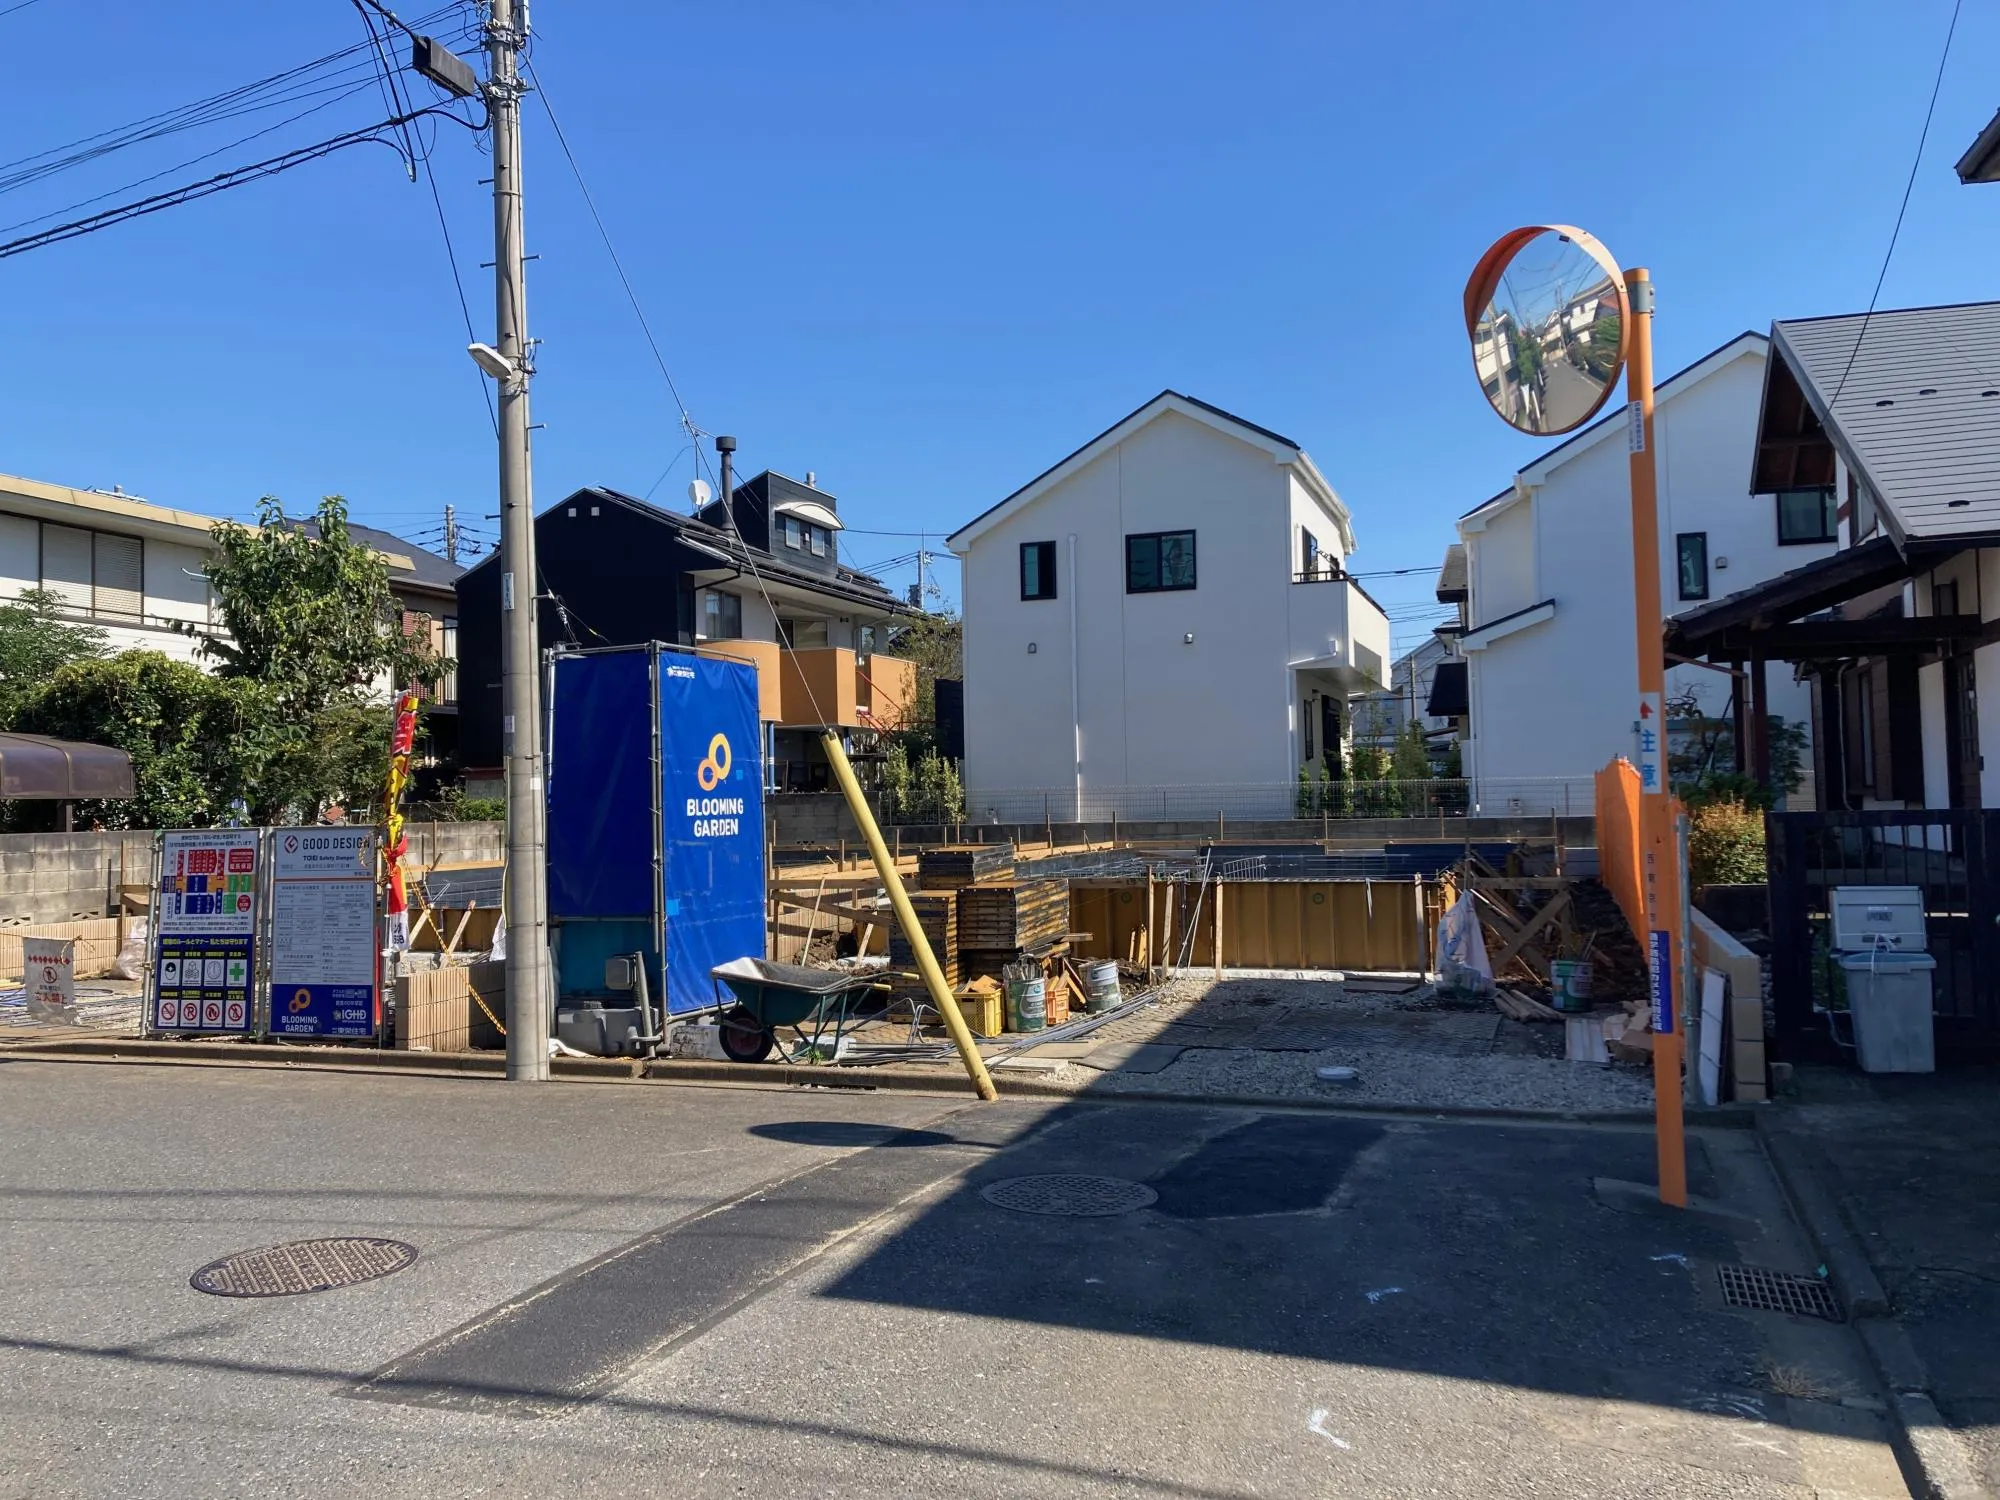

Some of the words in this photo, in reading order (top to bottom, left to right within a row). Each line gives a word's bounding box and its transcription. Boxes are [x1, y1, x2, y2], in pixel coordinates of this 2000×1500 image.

[687, 798, 743, 816] BLOOMING
[694, 818, 739, 837] GARDEN
[302, 838, 330, 850] GOOD
[281, 1015, 318, 1023] BLOOMING
[285, 1024, 314, 1033] GARDEN
